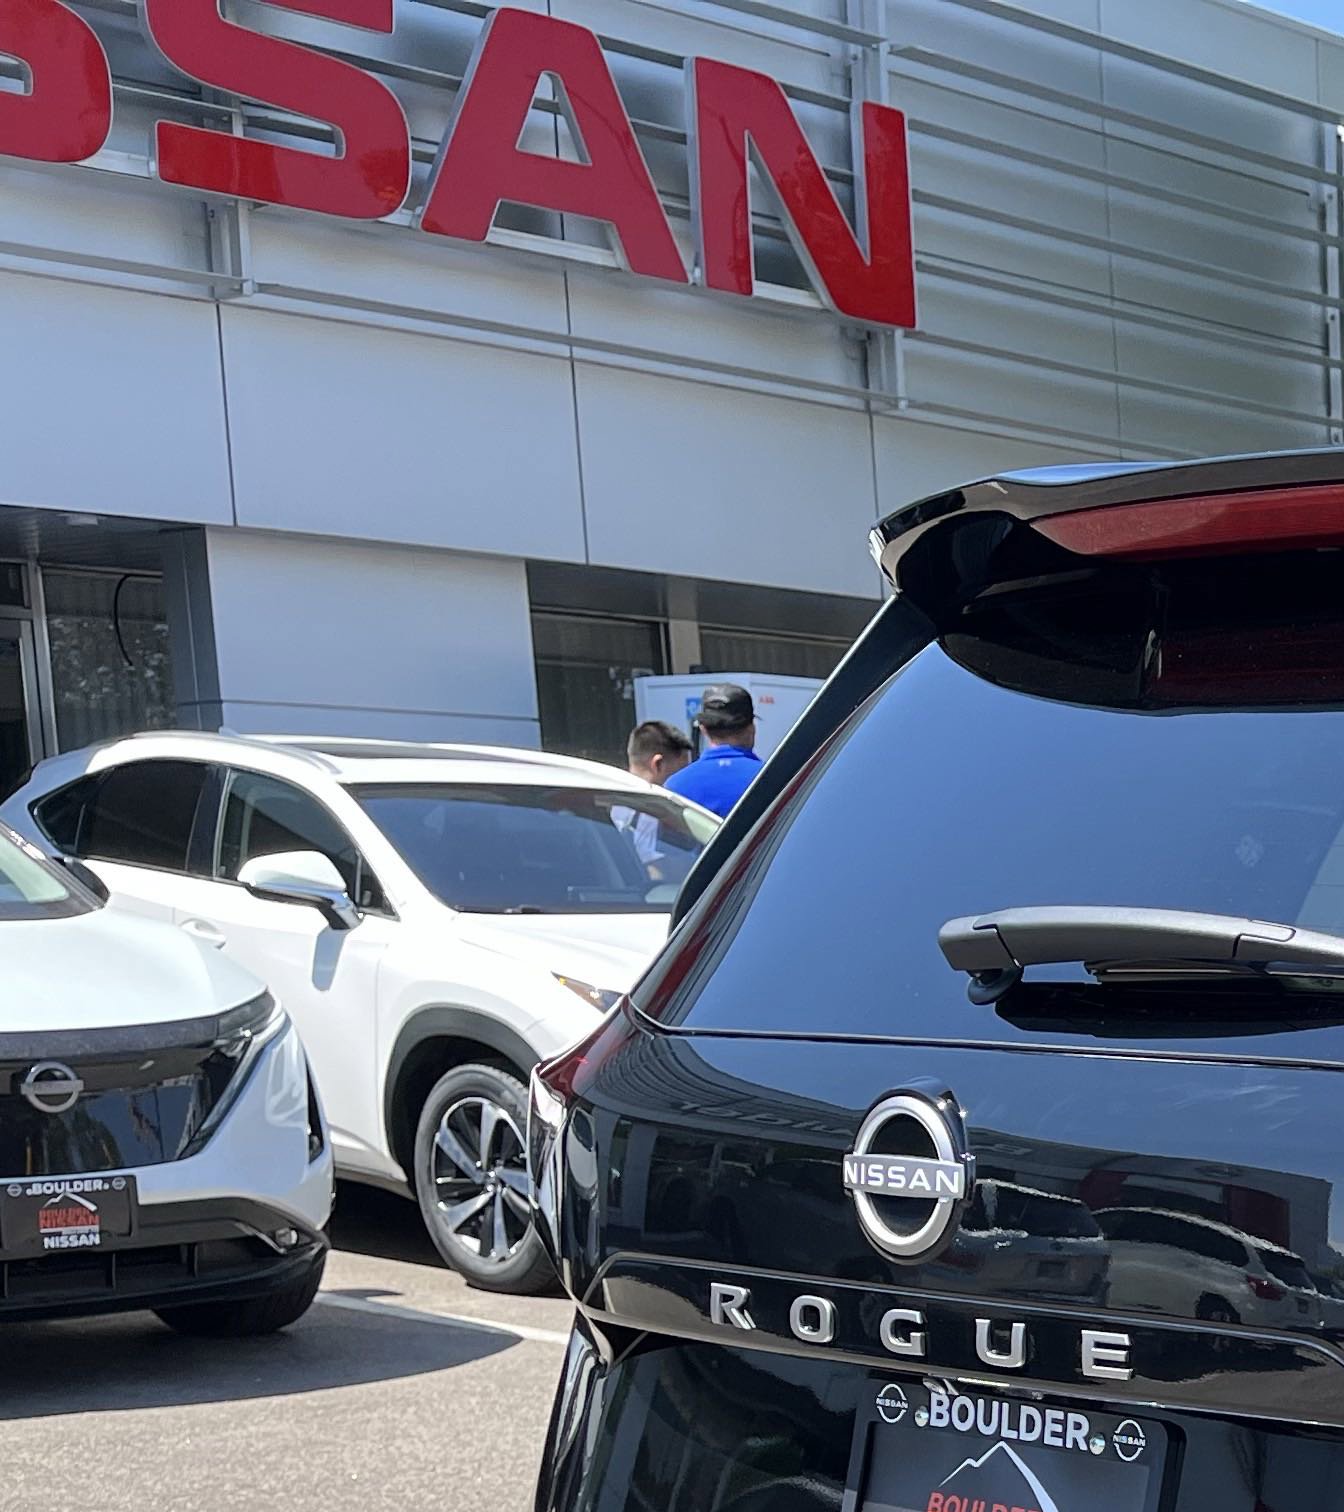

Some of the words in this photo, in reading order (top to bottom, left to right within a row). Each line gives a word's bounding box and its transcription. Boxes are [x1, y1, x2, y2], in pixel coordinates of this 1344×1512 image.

[844, 1159, 960, 1194] NISSAN
[31, 1179, 104, 1196] BOULDER
[44, 1233, 101, 1249] NISSAN
[709, 1282, 1134, 1381] ROGUE
[876, 1398, 909, 1410] NISSAN
[929, 1391, 1090, 1451] BOULDER
[1112, 1434, 1146, 1447] NISSAN
